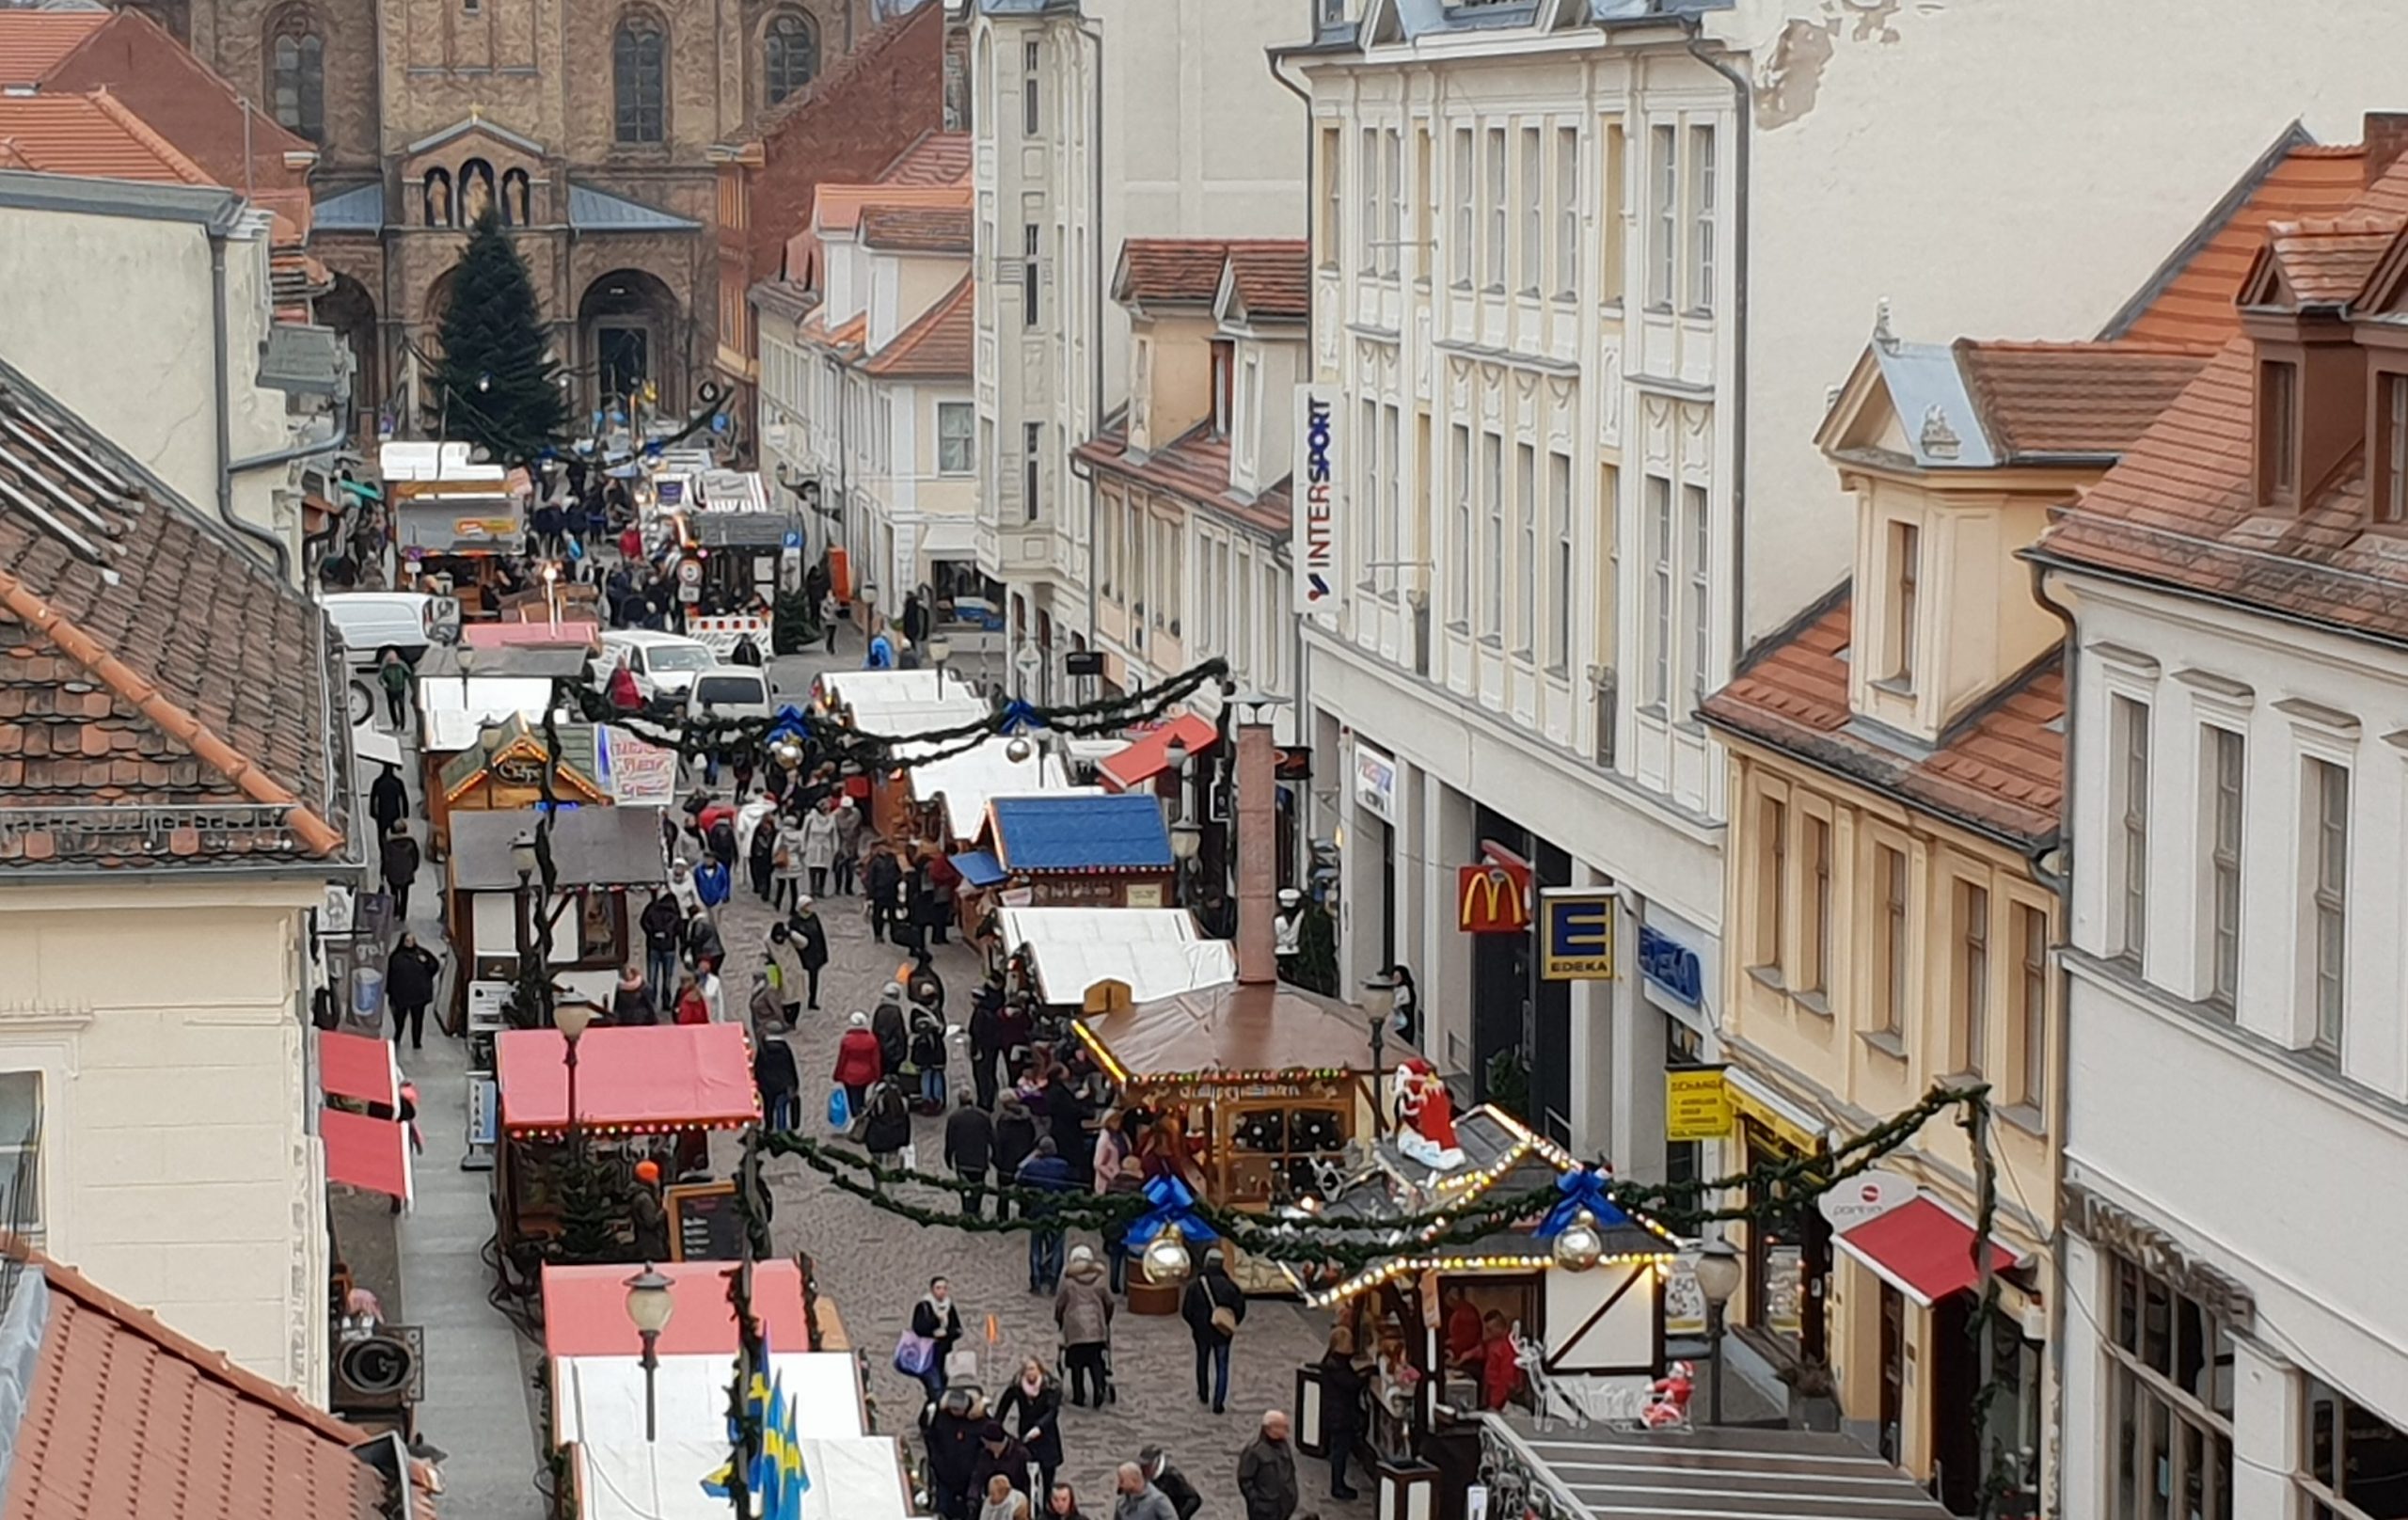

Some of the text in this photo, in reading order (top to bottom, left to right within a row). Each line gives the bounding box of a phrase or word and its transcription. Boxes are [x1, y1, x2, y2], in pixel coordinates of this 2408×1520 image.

[1307, 392, 1331, 567] INTERSPORT
[786, 532, 797, 546] P
[1551, 961, 1608, 973] EDEKA
